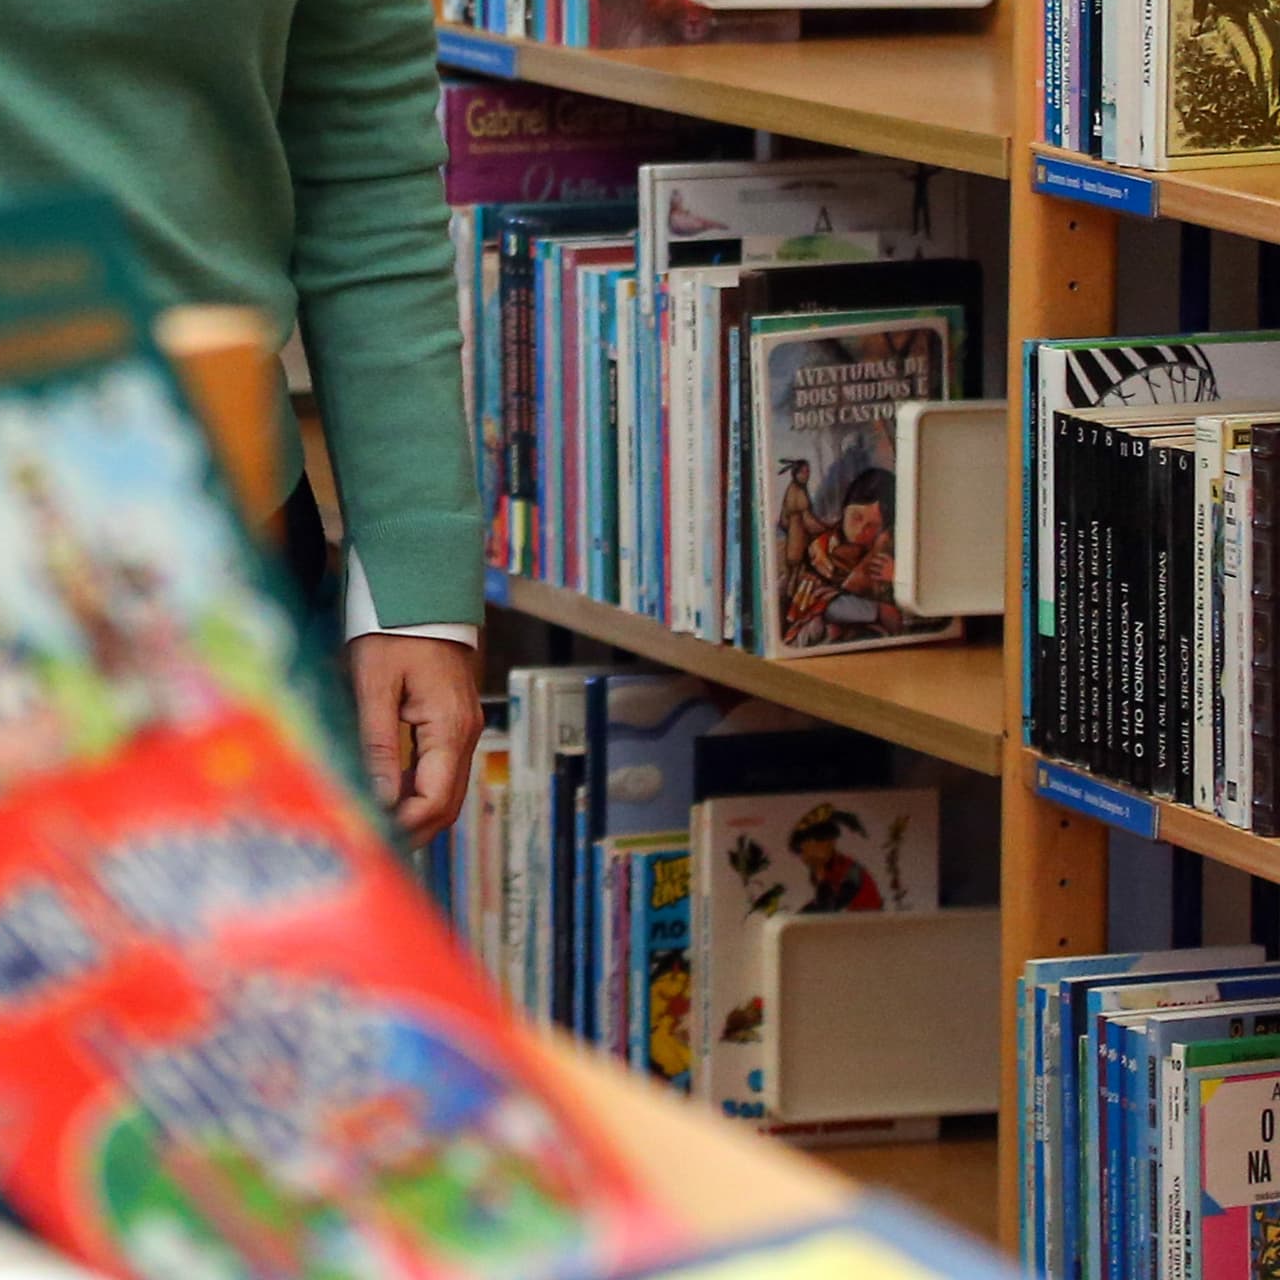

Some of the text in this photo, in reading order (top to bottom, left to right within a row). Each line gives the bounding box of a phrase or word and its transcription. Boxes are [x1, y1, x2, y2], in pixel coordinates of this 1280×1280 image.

[1052, 42, 1061, 85] LUGAR
[793, 354, 929, 387] AVENTURAS DE
[795, 385, 838, 407] DOIS
[792, 403, 835, 430] DOIS
[1060, 418, 1068, 436] 2
[1076, 428, 1085, 443] 3
[1091, 430, 1099, 446] 7
[1105, 431, 1113, 447] 8
[1132, 440, 1144, 457] 13
[1159, 450, 1168, 466] 5
[1178, 454, 1188, 471] 6
[1090, 582, 1100, 604] DA
[1157, 551, 1167, 640] SUBMARINAS
[1195, 596, 1206, 651] Mundo
[1059, 639, 1068, 662] DO
[1196, 654, 1206, 674] ao
[1058, 665, 1069, 712] FILHOS
[1091, 687, 1100, 716] 500
[1134, 621, 1145, 758] O TIO ROBINSON
[1195, 677, 1206, 712] volta
[1059, 713, 1069, 734] OS
[1120, 700, 1130, 736] ILHA
[1157, 701, 1167, 727] MIL
[1091, 720, 1100, 743] OS
[1120, 741, 1130, 753] A
[1157, 731, 1168, 769] VINTE
[1180, 719, 1191, 775] MIGUEL
[1261, 1108, 1275, 1144] O
[1247, 1148, 1273, 1185] NA
